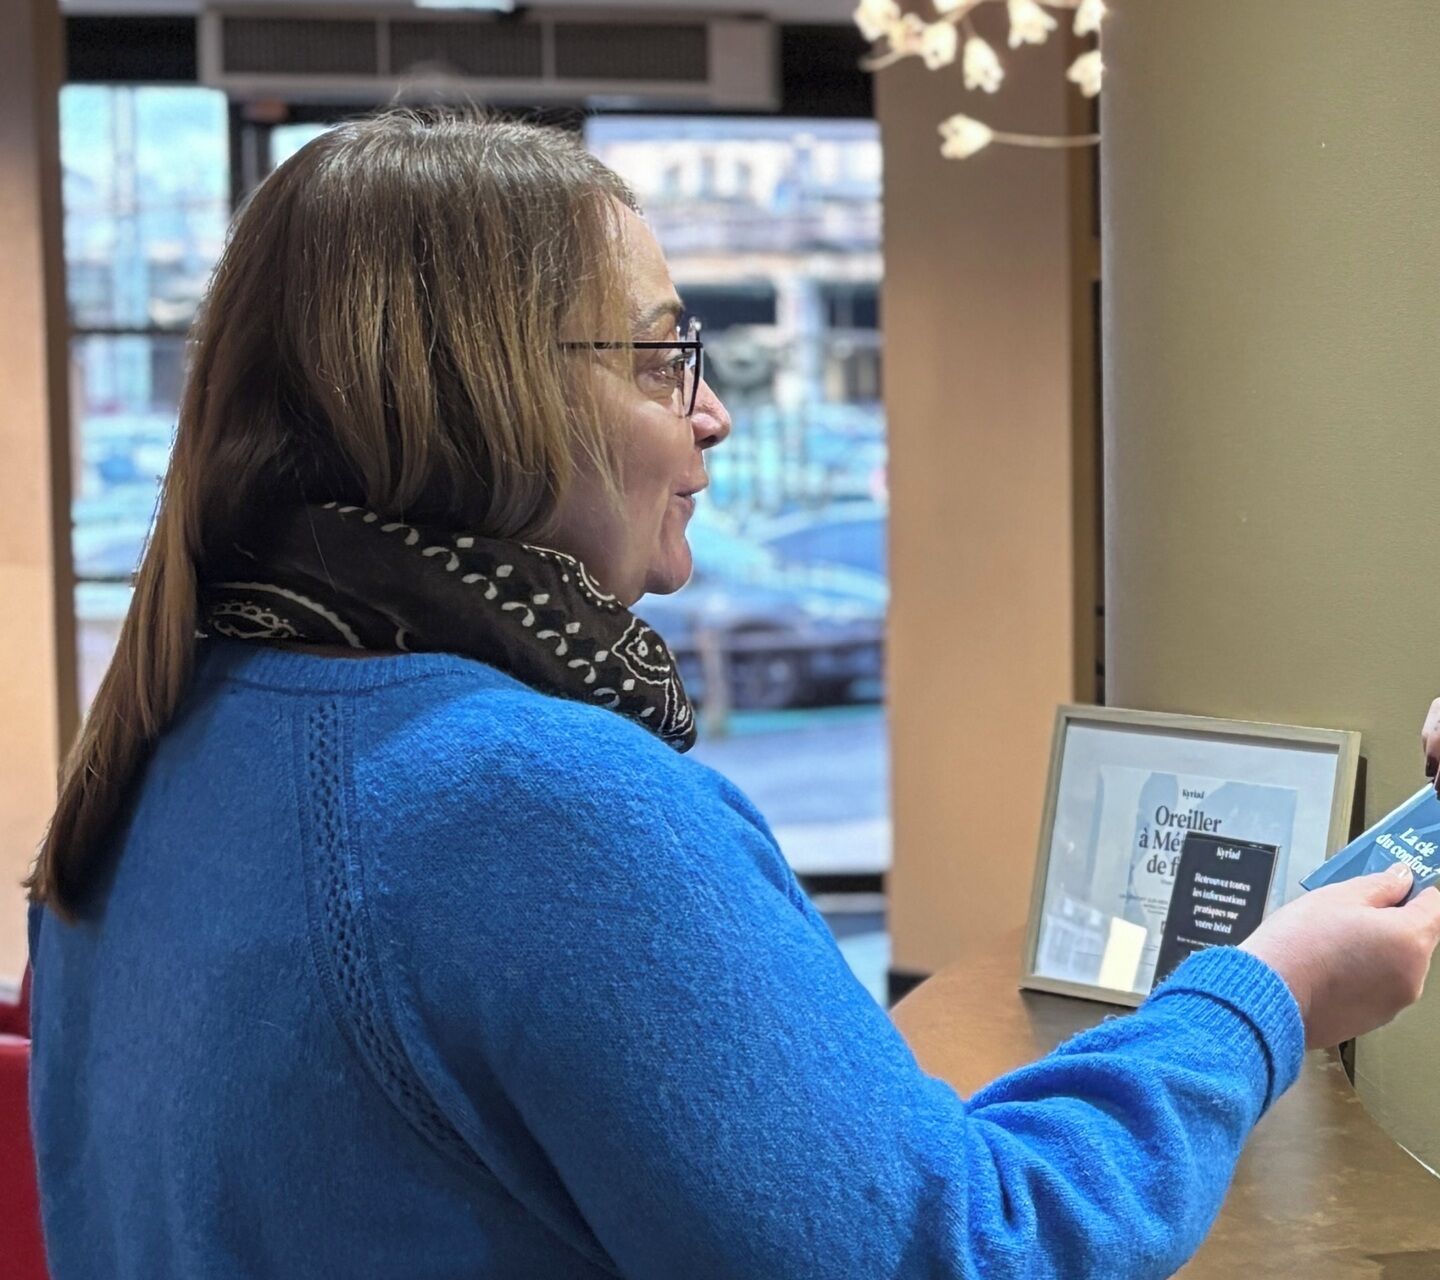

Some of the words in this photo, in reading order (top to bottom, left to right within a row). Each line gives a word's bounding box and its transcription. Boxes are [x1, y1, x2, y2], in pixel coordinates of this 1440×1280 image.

[1182, 788, 1205, 800] Kyriad
[1155, 805, 1222, 833] Oreiller
[1138, 827, 1150, 849] à
[1399, 827, 1419, 846] La
[1414, 841, 1439, 857] clé
[1146, 853, 1168, 875] de
[1216, 846, 1241, 860] Kyriad
[1375, 833, 1395, 850] du
[1390, 845, 1434, 877] confort
[1203, 889, 1246, 907] informations
